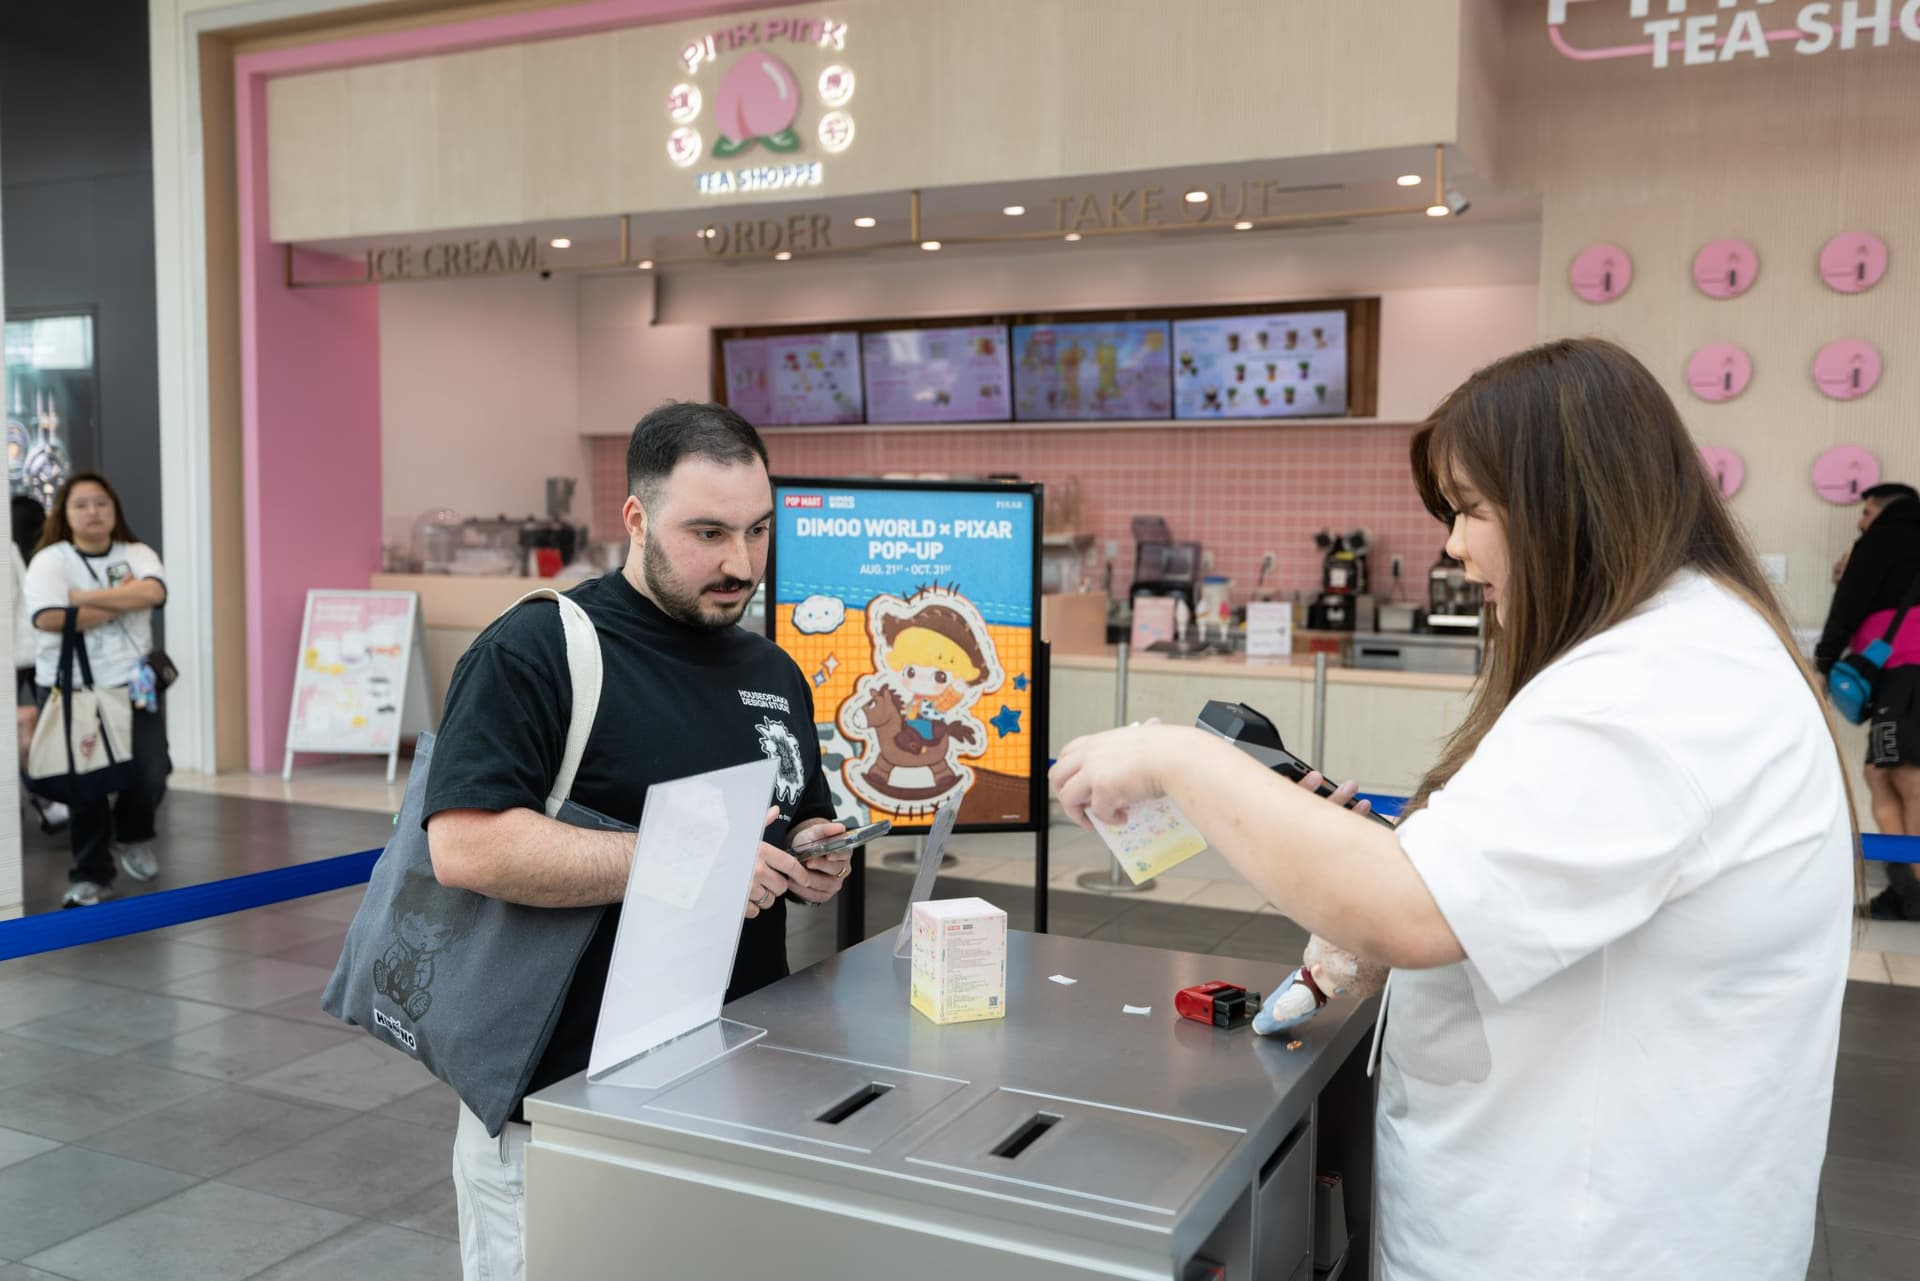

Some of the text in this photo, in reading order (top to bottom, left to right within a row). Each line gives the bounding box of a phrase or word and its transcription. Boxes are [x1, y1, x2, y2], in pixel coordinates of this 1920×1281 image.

[1643, 10, 1770, 69] TEA
[696, 161, 823, 194] TEA SHOPPE
[1049, 179, 1279, 232] TAKE OUT
[702, 213, 832, 257] ORDER
[365, 235, 539, 281] ICE CREAM
[785, 496, 800, 507] POP
[796, 517, 861, 537] DIMOO
[864, 518, 936, 538] WORLD
[954, 520, 1012, 539] PIXAR
[868, 541, 944, 560] POP-UP
[859, 564, 884, 575] AUG.
[911, 564, 932, 575] OCT.
